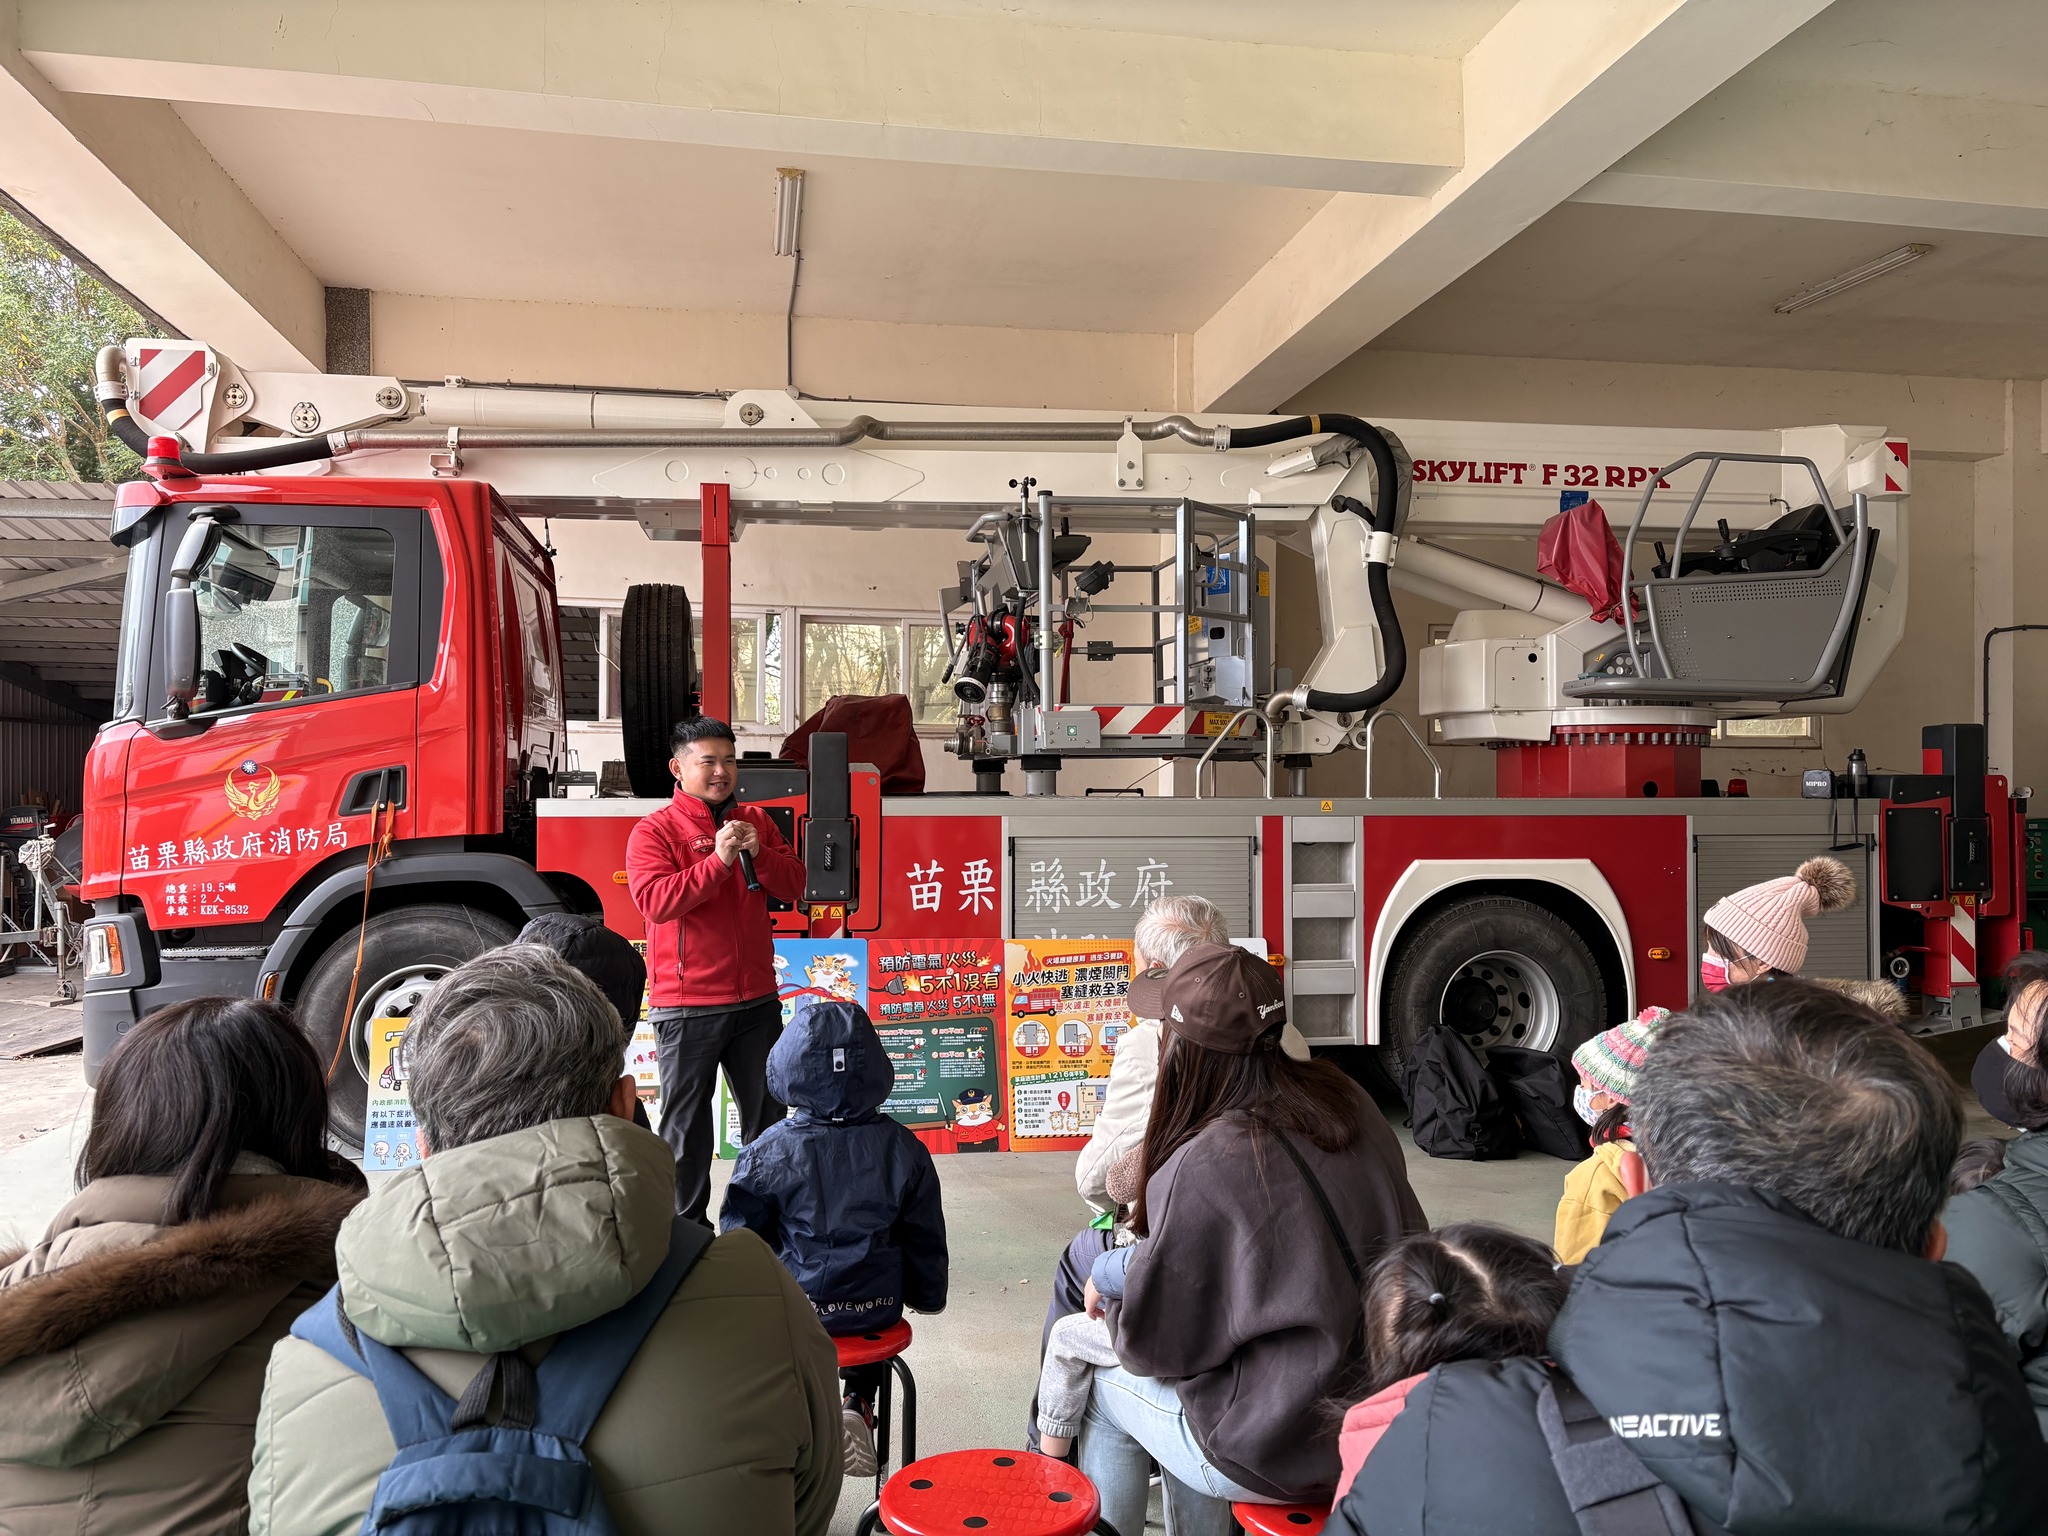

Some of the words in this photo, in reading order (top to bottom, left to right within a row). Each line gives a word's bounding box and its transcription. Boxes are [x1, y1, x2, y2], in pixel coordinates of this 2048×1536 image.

[1542, 463, 1558, 486] F
[1564, 464, 1599, 487] 32
[1605, 465, 1671, 489] RPX
[10, 816, 33, 825] YAMAHA
[127, 822, 349, 872] 苗栗縣政府消防局
[1012, 969, 1069, 986] 小火快逃
[1074, 965, 1131, 982] 濃煙關門
